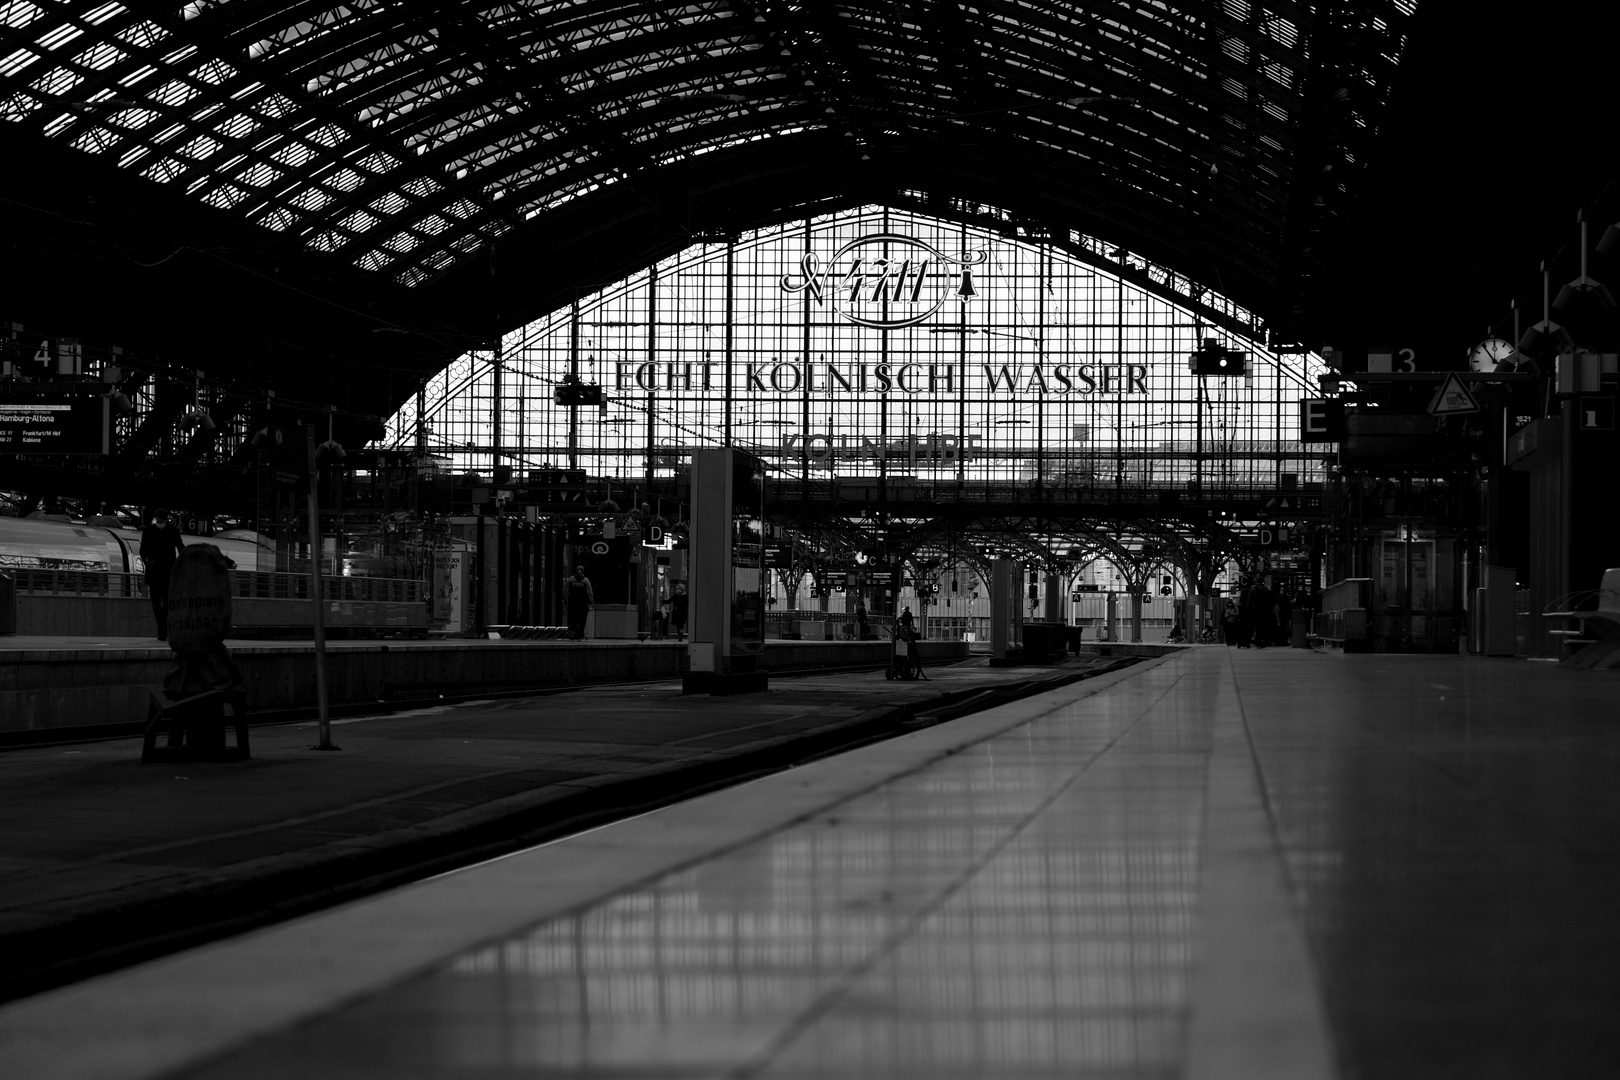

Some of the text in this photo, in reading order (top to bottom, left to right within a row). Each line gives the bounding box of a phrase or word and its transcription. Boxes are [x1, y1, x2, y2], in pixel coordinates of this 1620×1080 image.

[836, 257, 930, 304] 4711
[34, 340, 51, 367] 4
[1397, 348, 1416, 373] 3
[615, 356, 1150, 395] ECHT KÖLNISCH WASSER
[0, 415, 54, 424] Hamburg-Altona
[1306, 400, 1327, 433] E
[782, 433, 982, 463] KÖLN HBF
[189, 518, 196, 530] 6
[651, 526, 662, 541] D
[1261, 530, 1272, 545] D
[869, 556, 876, 566] C
[1241, 576, 1248, 586] C
